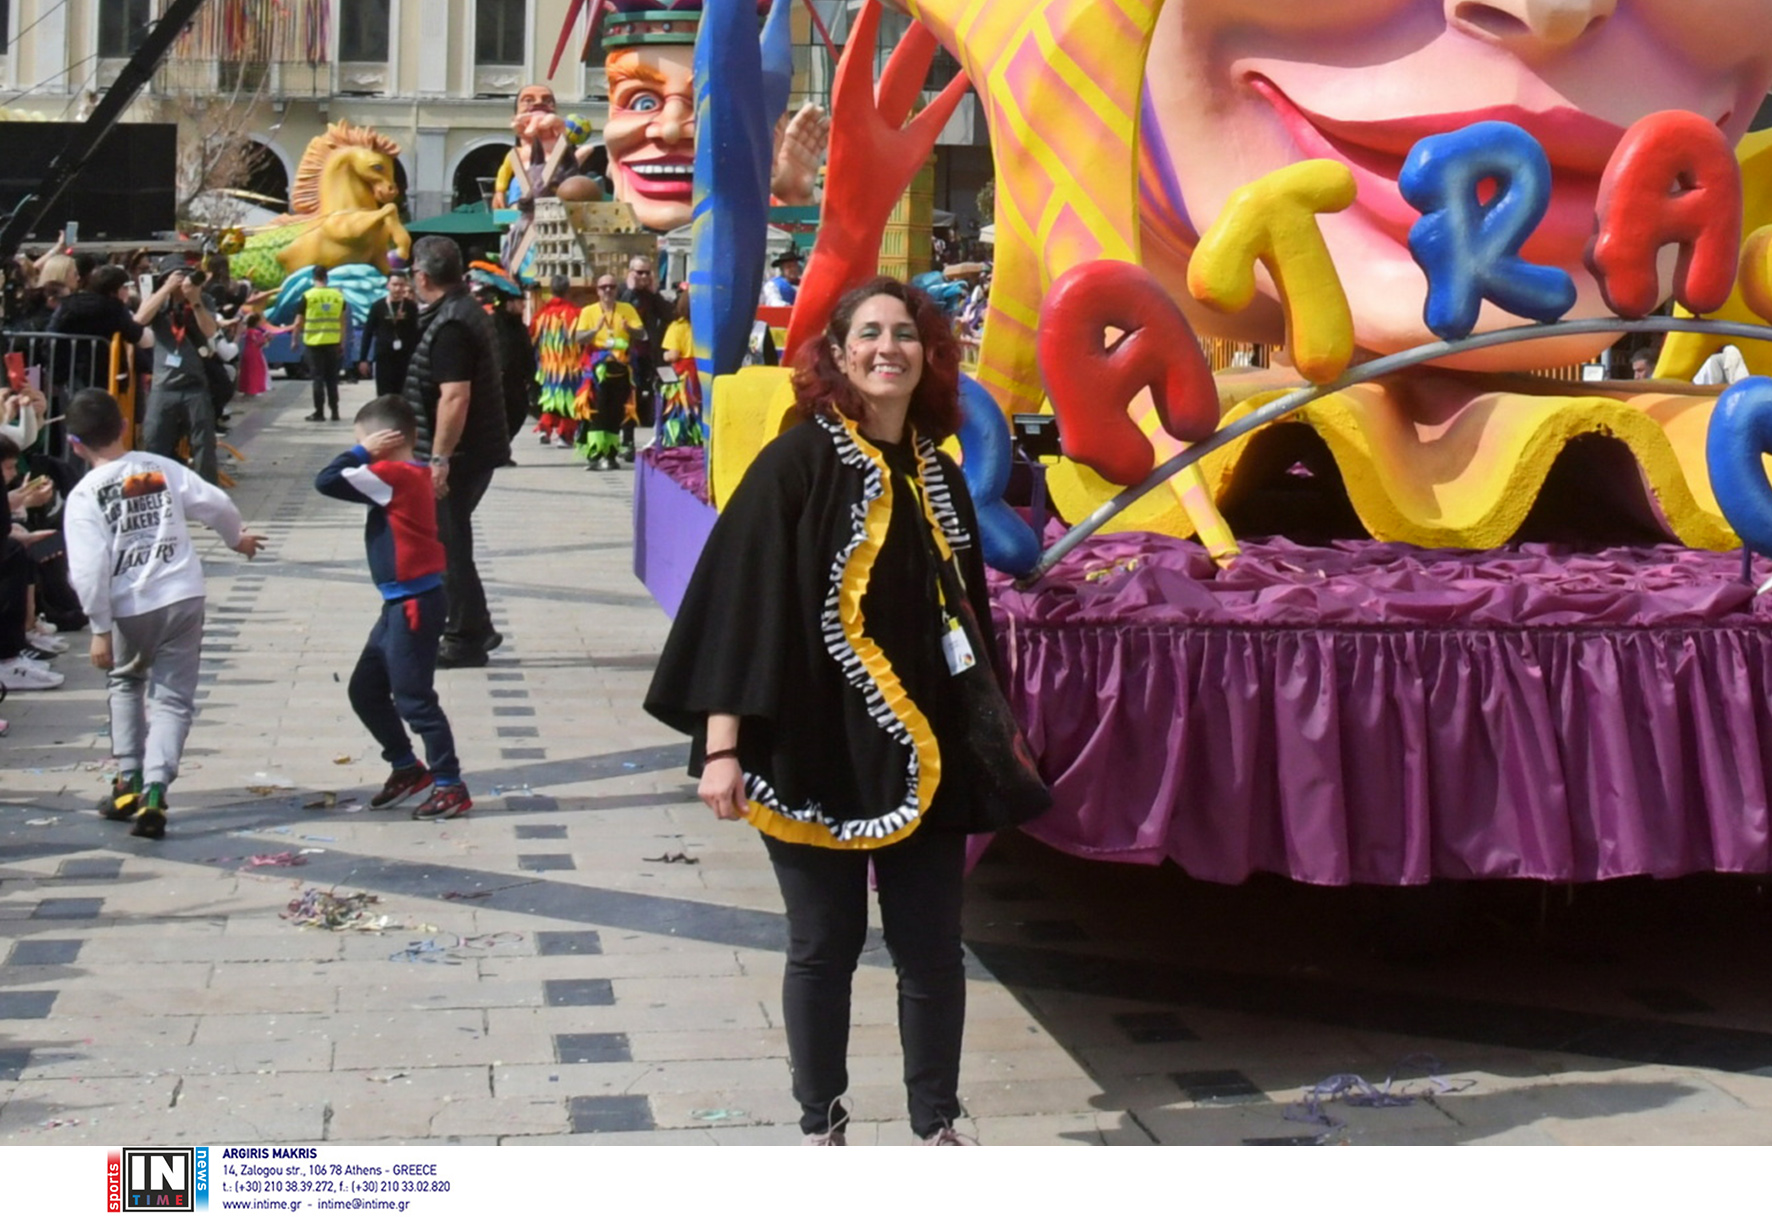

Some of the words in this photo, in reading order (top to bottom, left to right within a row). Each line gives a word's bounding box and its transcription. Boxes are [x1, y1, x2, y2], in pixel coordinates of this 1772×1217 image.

[105, 502, 122, 525] LOS
[127, 492, 172, 515] ANGELES
[120, 510, 161, 533] LAKERS
